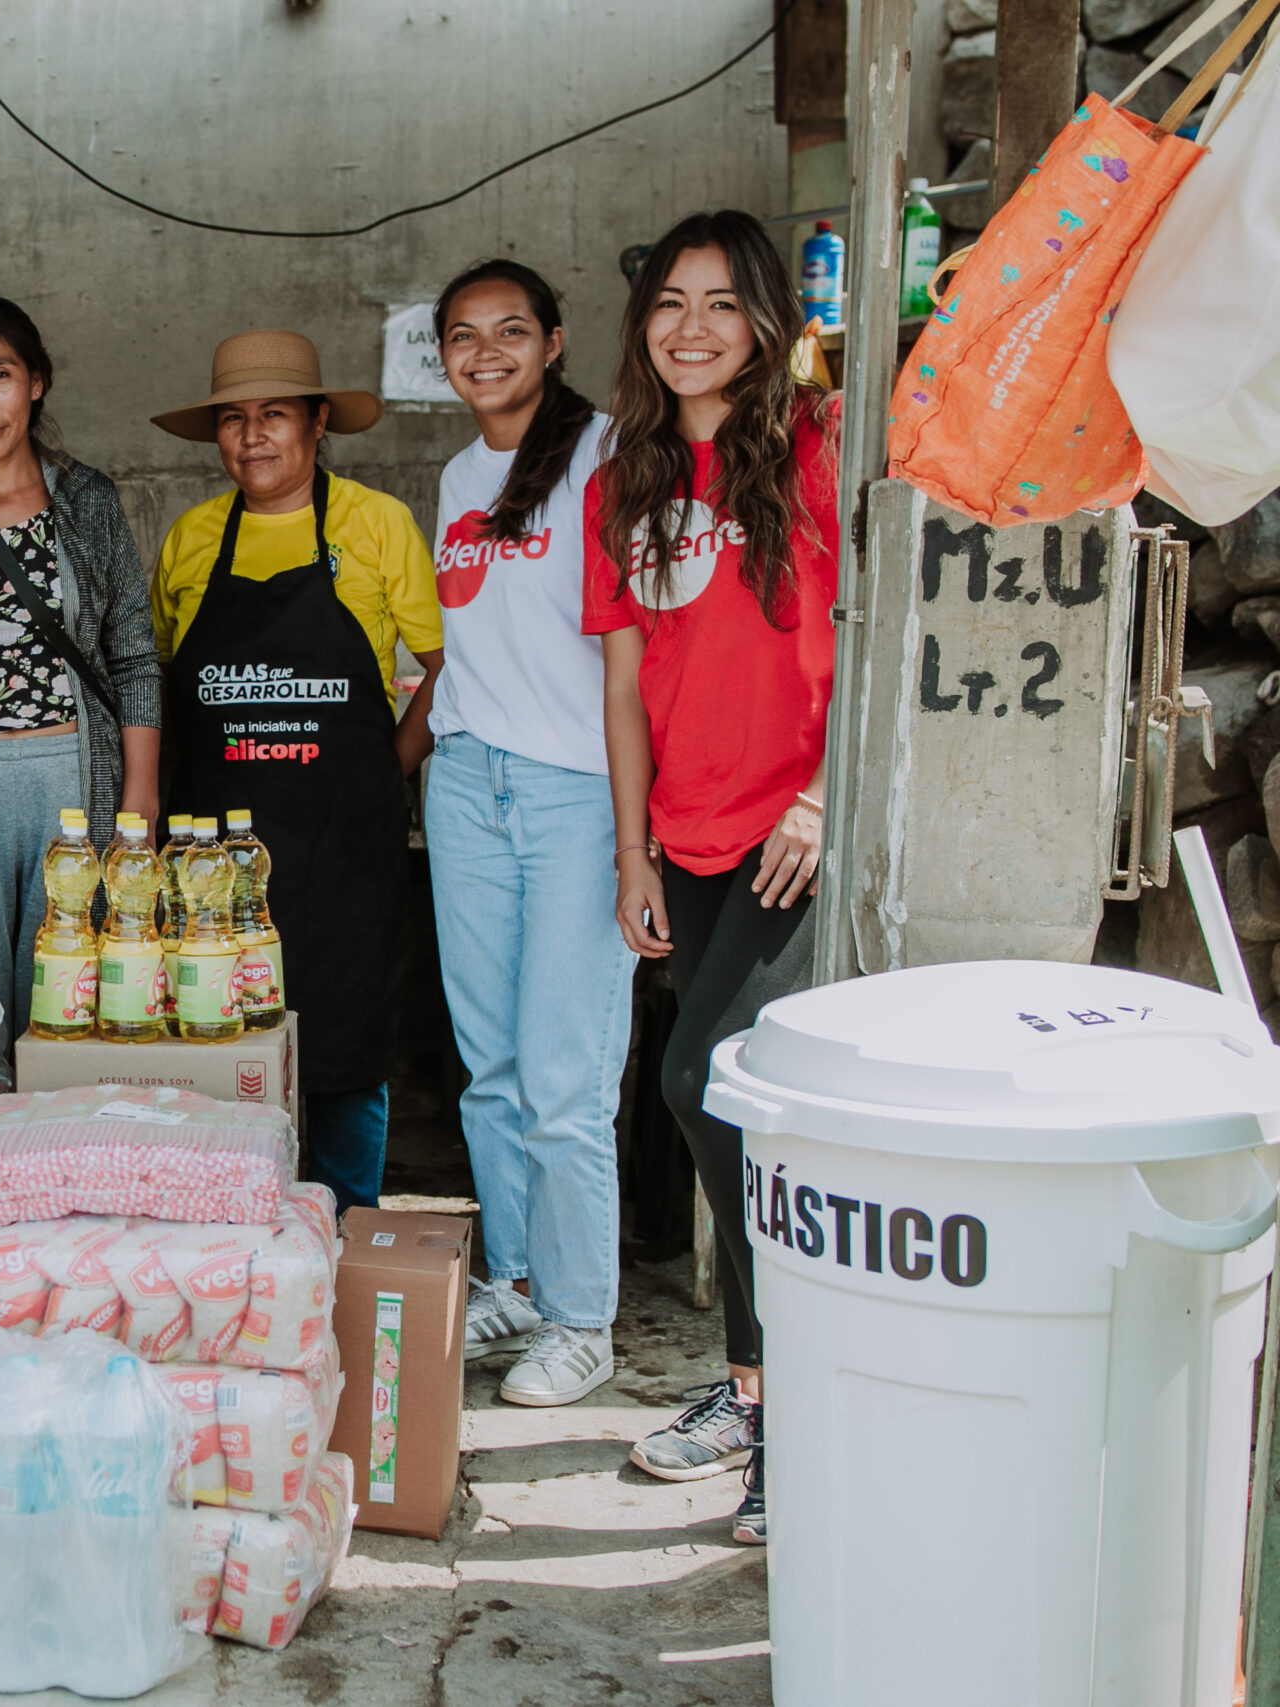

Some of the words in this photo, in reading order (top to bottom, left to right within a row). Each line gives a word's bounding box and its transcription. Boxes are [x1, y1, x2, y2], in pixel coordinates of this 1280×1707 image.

[406, 330, 437, 345] LAV
[199, 663, 268, 684] OLLAS
[269, 667, 294, 681] que
[201, 682, 346, 702] DESARROLLAN
[223, 721, 246, 734] Una
[248, 720, 301, 733] iniciativa
[303, 719, 319, 732] de
[242, 966, 269, 980] ega
[78, 979, 97, 992] veg
[98, 1077, 133, 1086] ACEITE
[138, 1077, 165, 1086] 100%
[169, 1078, 195, 1086] SOYA
[746, 1154, 987, 1287] PLÁSTICO
[192, 1261, 248, 1293] veg
